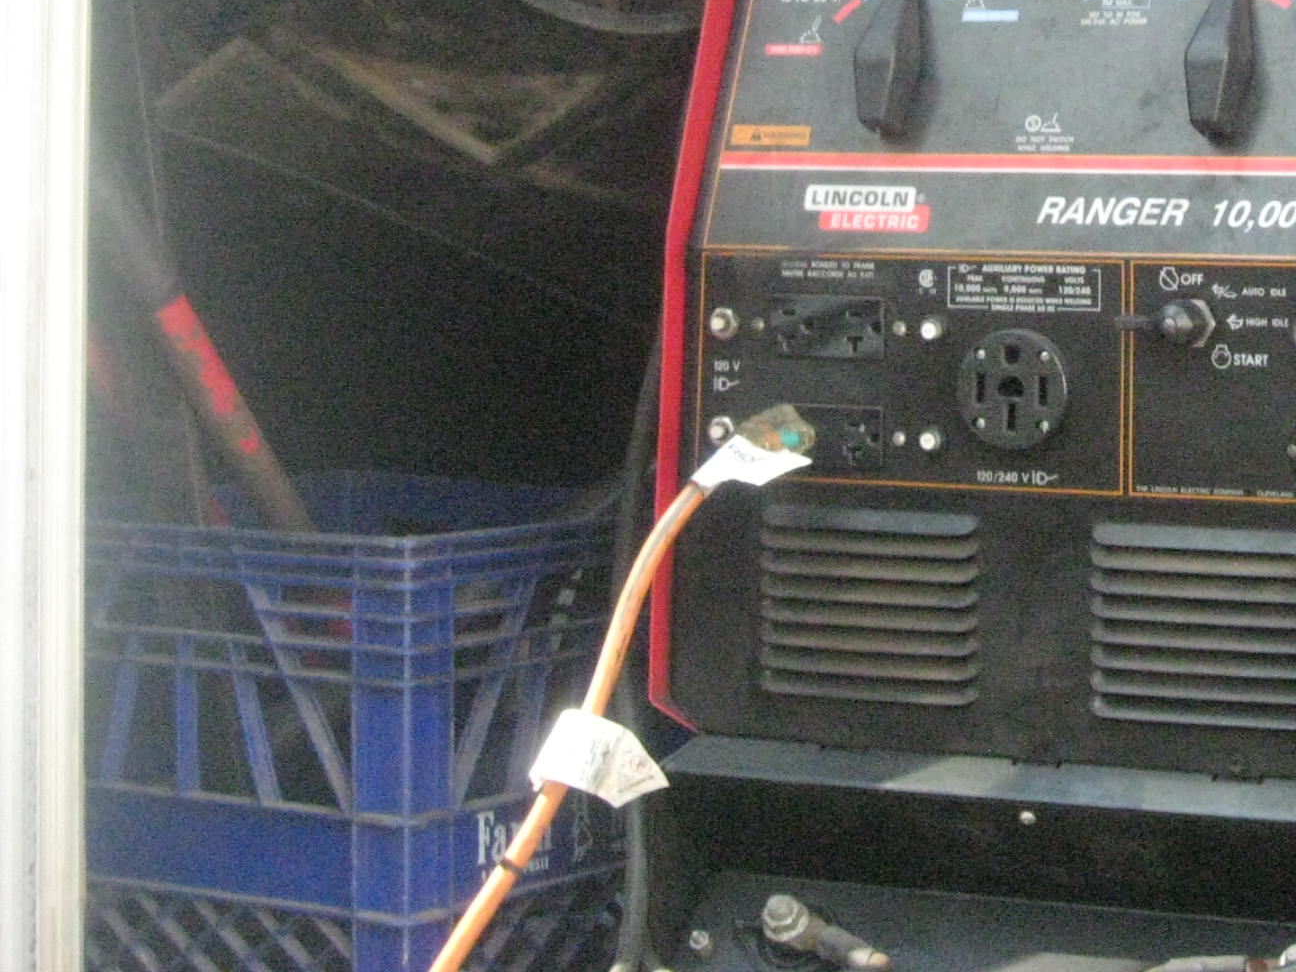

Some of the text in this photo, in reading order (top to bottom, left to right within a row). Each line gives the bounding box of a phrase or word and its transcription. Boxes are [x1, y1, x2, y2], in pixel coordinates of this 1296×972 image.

[811, 189, 909, 207] LINCOLN
[1037, 196, 1190, 226] RANGER
[831, 213, 919, 229] ELECTRIC
[1024, 265, 1053, 273] POWER
[1056, 266, 1086, 274] RATING
[1181, 274, 1204, 286] OFF
[1242, 287, 1286, 297] AUTO IDLE
[1246, 318, 1289, 327] HIGH IDLE
[714, 360, 741, 371] 120 V
[1234, 354, 1268, 367] START
[977, 470, 1030, 483] 120/240 V
